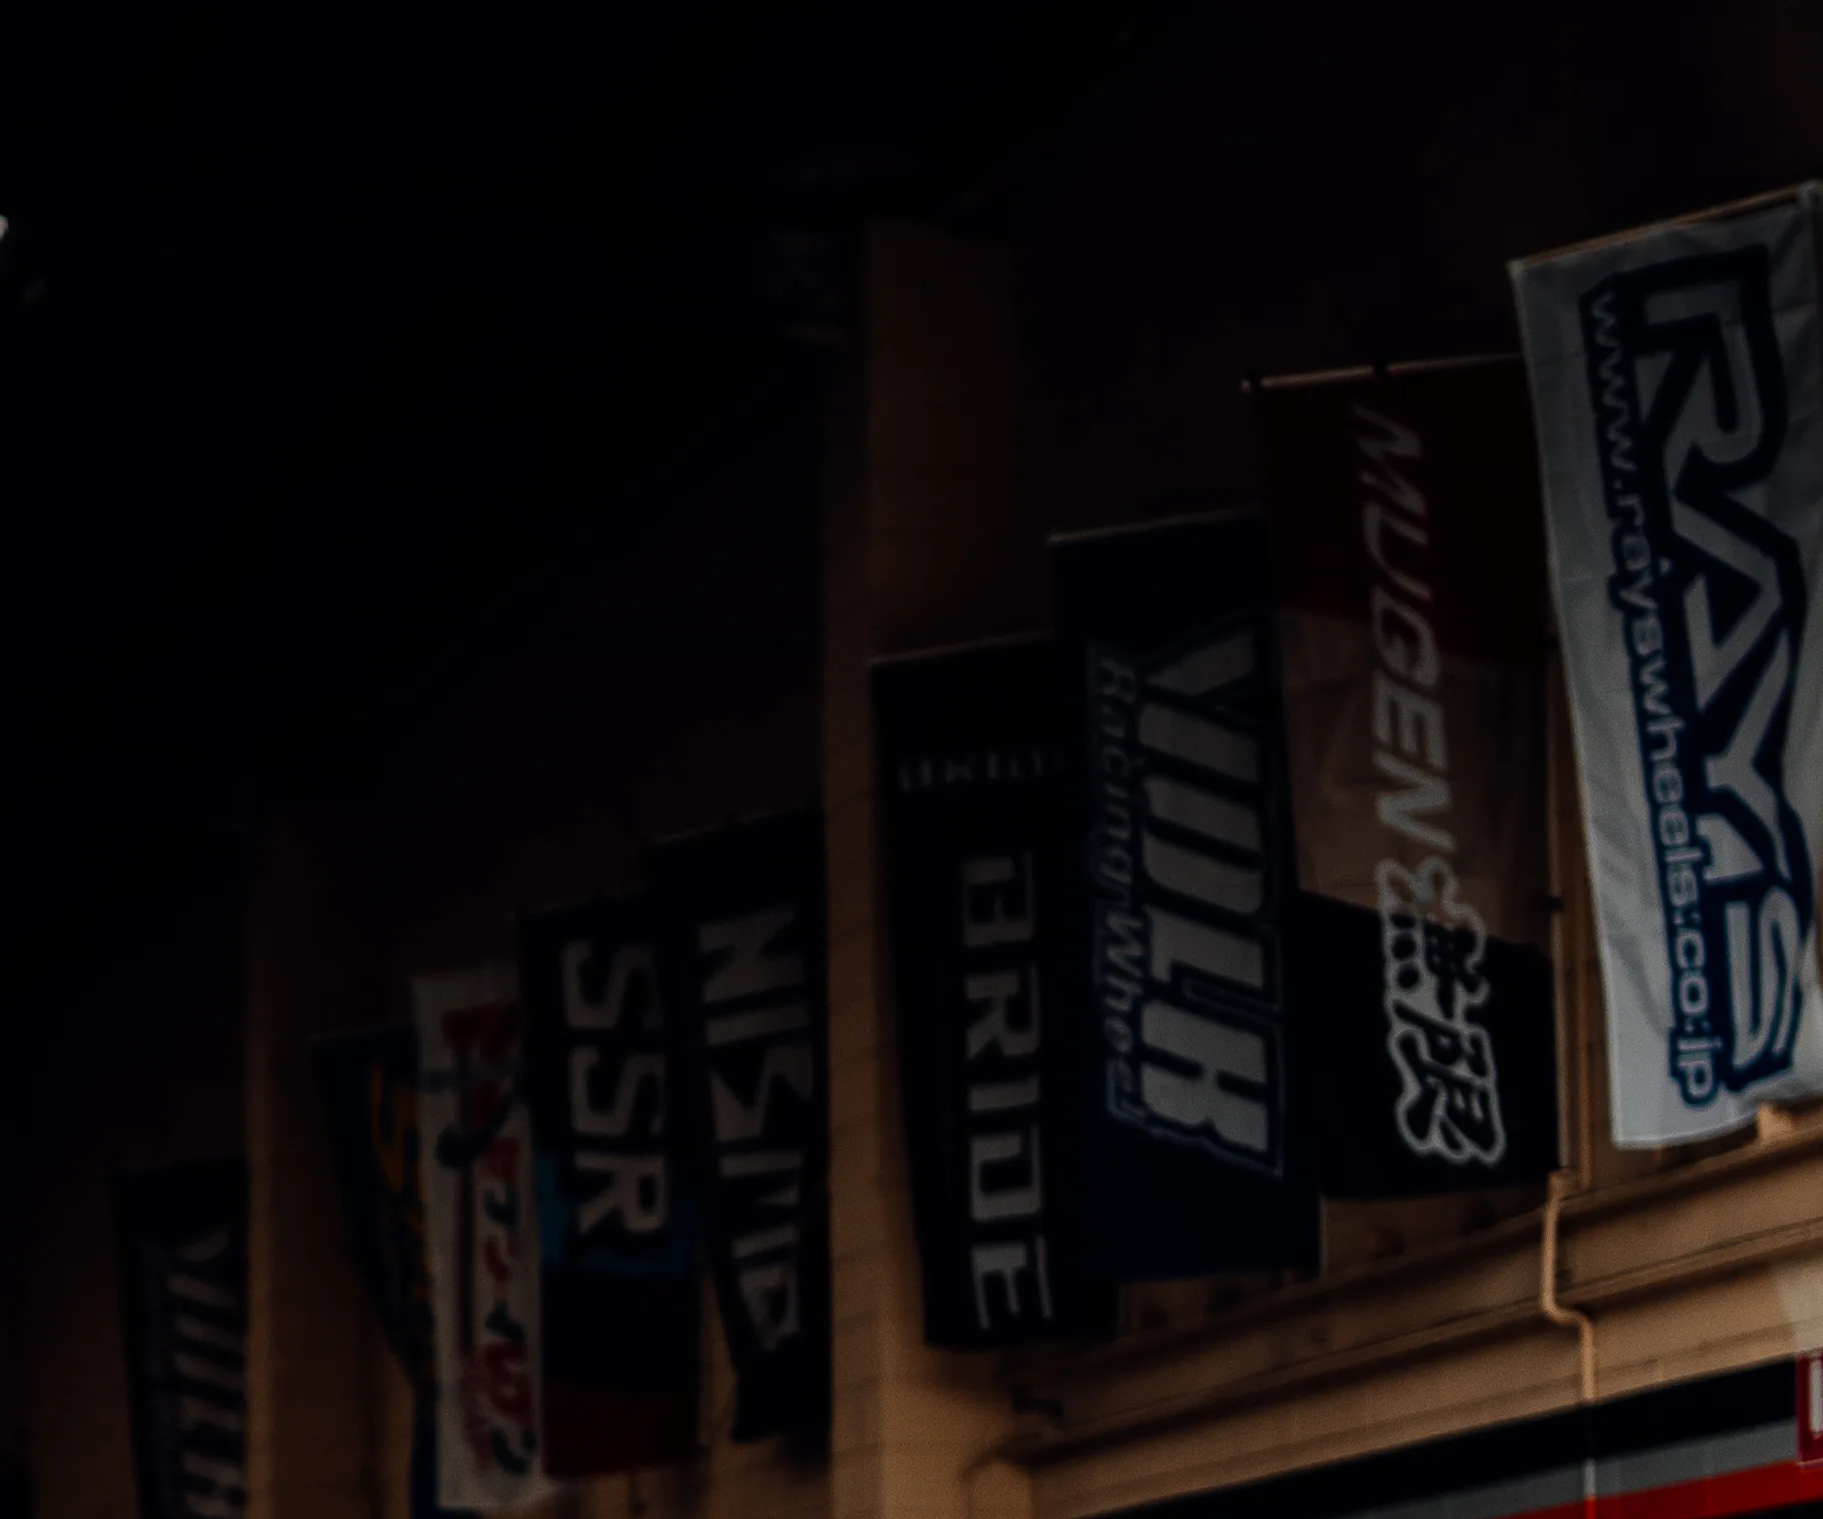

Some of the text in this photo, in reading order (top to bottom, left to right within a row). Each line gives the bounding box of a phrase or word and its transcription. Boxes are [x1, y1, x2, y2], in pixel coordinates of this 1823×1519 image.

[1351, 400, 1458, 854] MUGEN
[1637, 278, 1805, 1072] RAYS
[559, 937, 671, 1238] SSR
[956, 848, 1055, 1331] BRIDE
[1136, 626, 1269, 1157] VOLK
